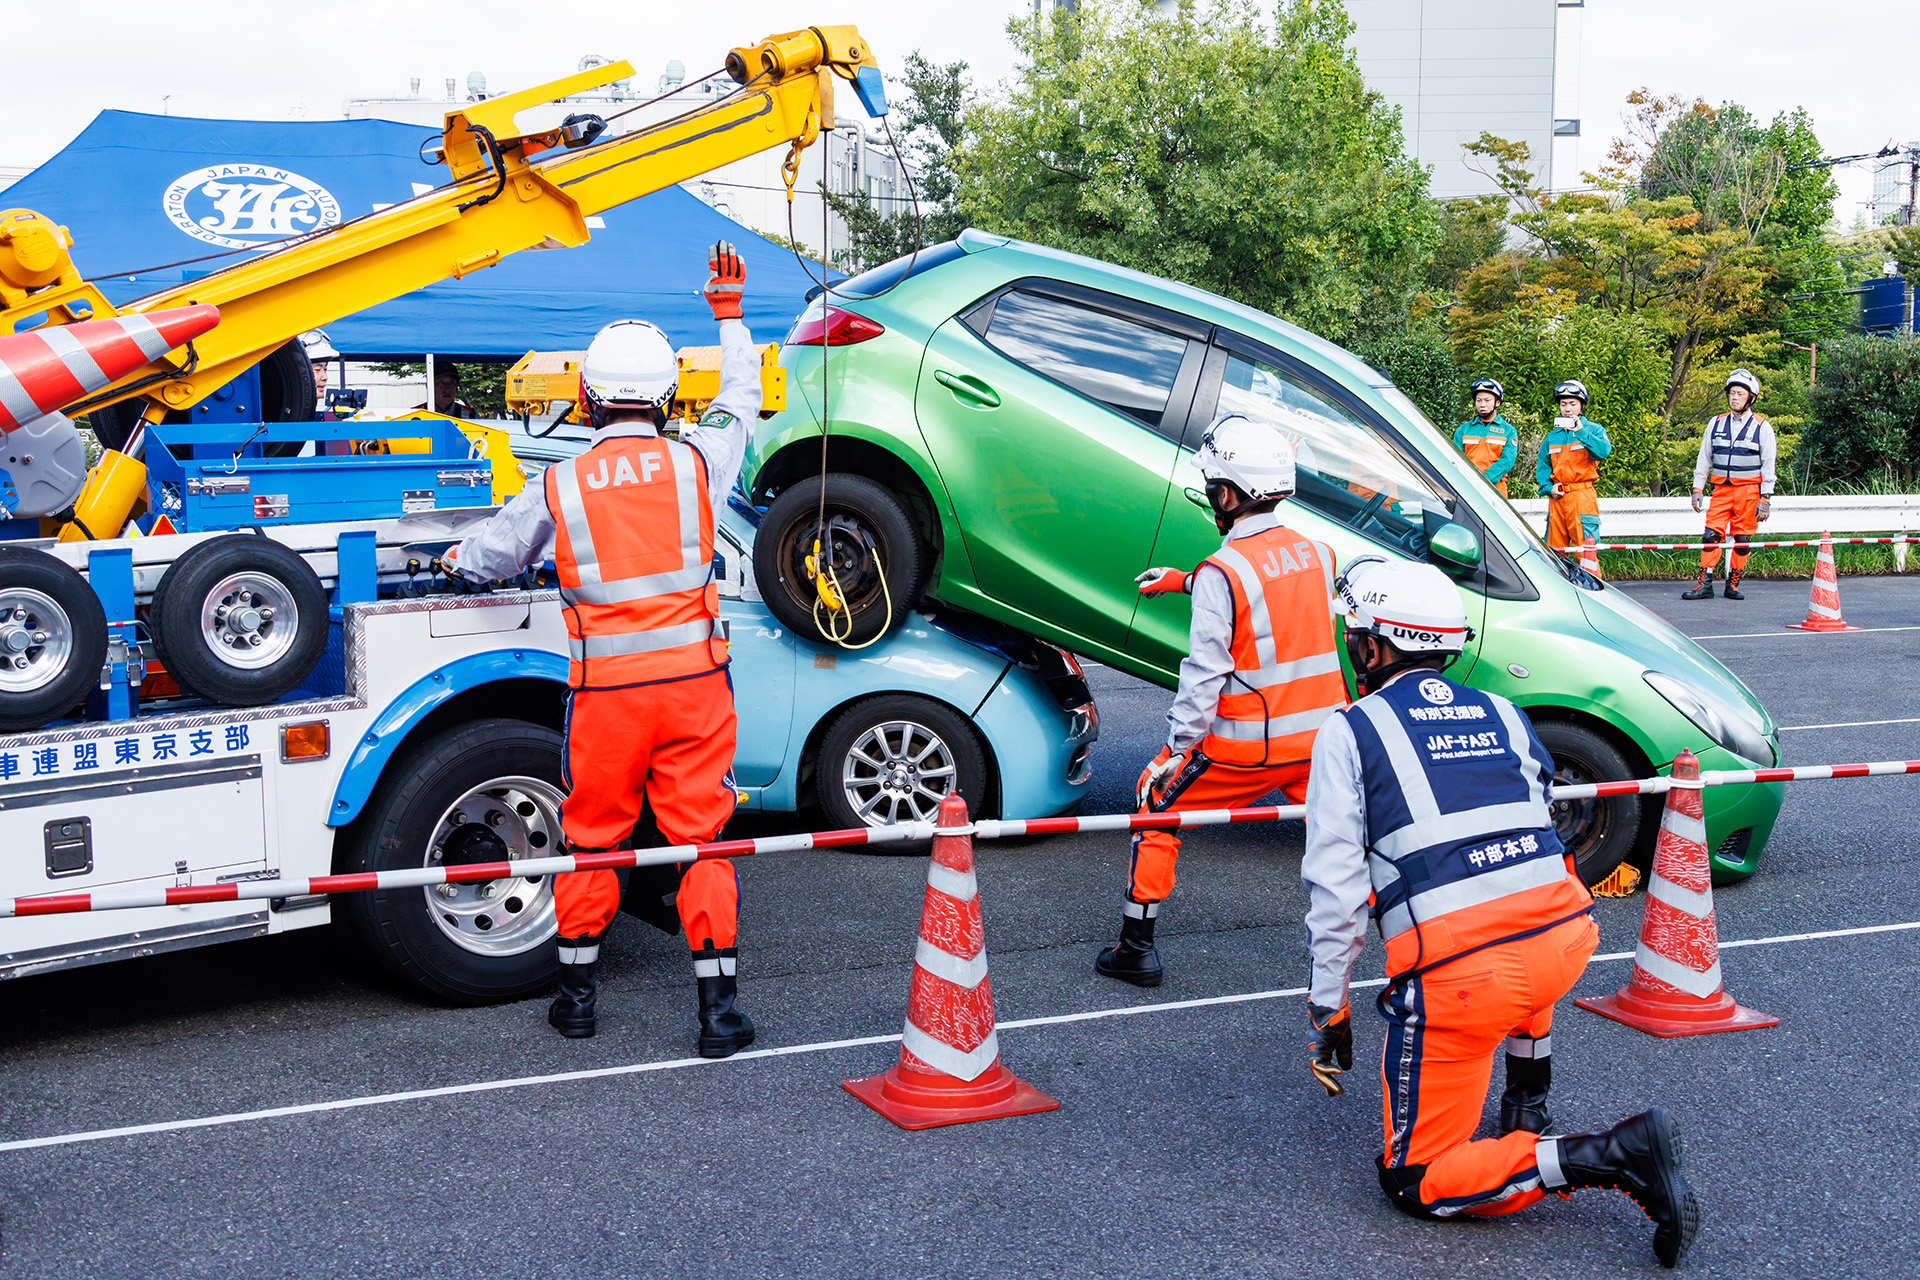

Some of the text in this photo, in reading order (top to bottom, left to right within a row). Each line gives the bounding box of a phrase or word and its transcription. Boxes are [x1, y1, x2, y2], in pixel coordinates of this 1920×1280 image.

[206, 166, 288, 180] JAPAN
[168, 185, 247, 249] FEDERATION
[1220, 450, 1236, 461] AF
[586, 452, 662, 490] JAF
[1262, 541, 1314, 578] JAF
[1362, 591, 1388, 606] JAF
[1392, 627, 1443, 644] uvex
[1408, 705, 1487, 721] 特別支援隊
[1426, 731, 1498, 751] JAF-FAST
[1470, 749, 1491, 757] Support
[1468, 834, 1539, 868] 中部本部
[1401, 1034, 1412, 1068] JAPAN
